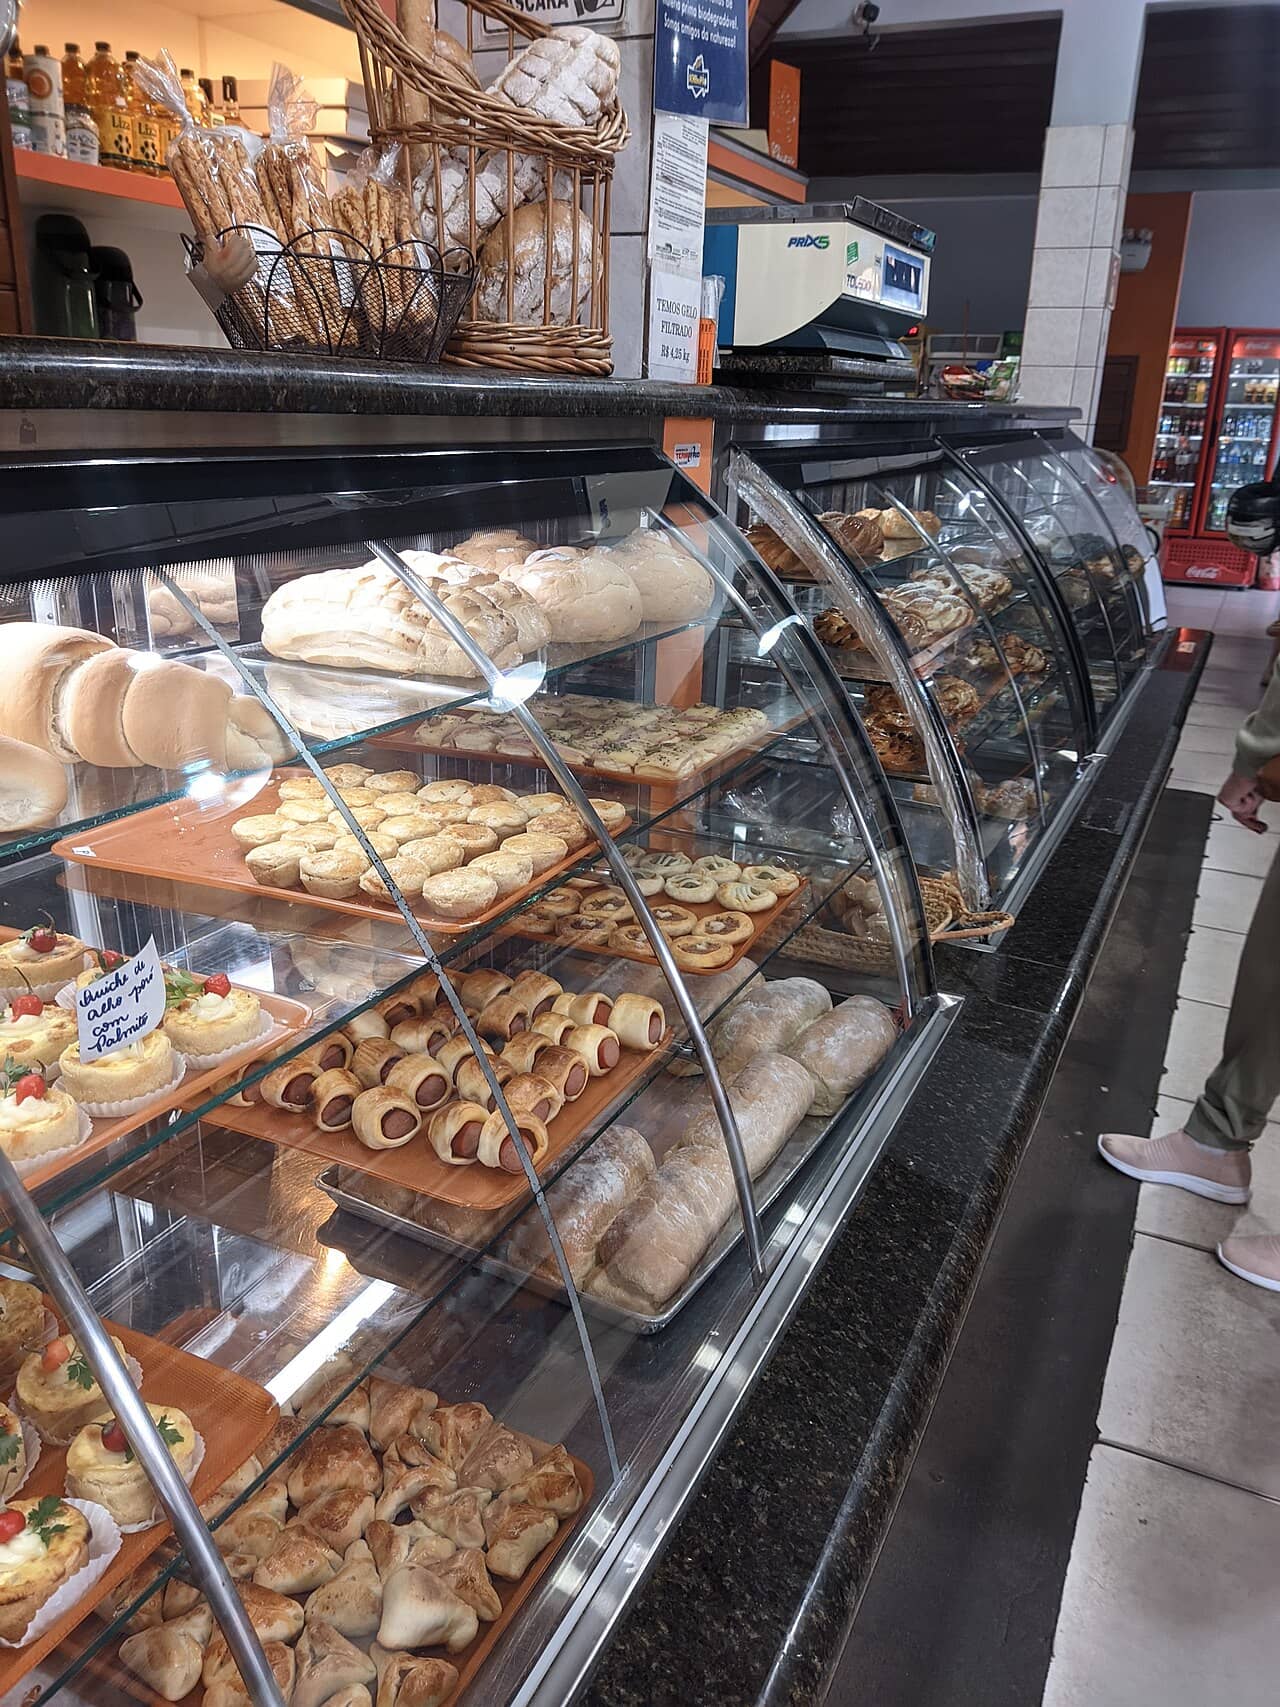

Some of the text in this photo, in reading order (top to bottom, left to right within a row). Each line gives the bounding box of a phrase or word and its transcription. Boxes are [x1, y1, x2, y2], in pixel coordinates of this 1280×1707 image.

[656, 298, 698, 320] TEMOS GELO
[661, 320, 693, 338] FILTRADO
